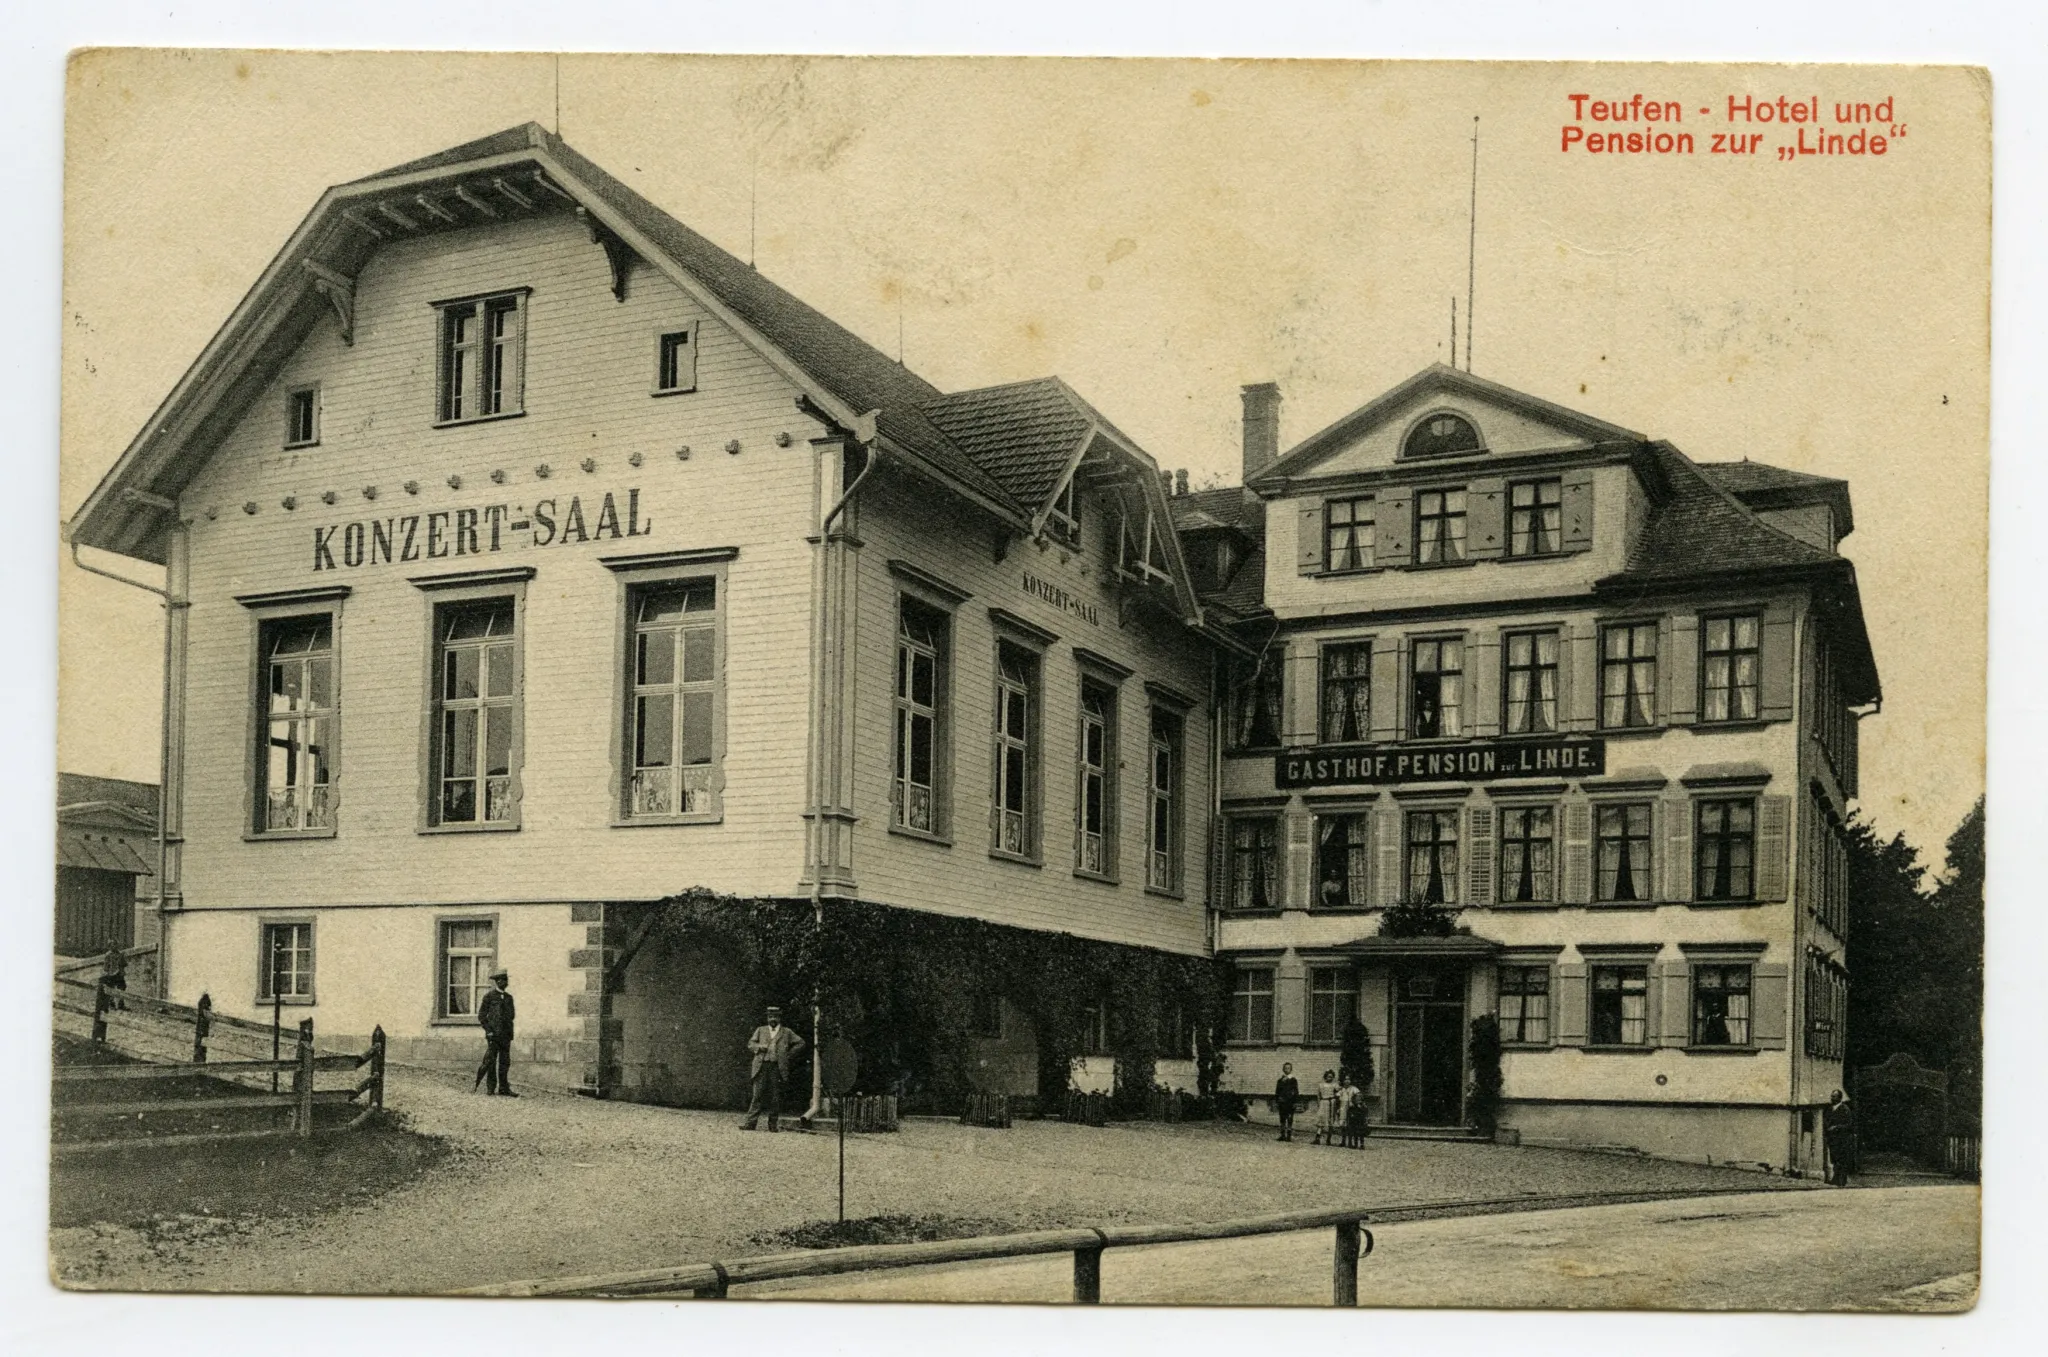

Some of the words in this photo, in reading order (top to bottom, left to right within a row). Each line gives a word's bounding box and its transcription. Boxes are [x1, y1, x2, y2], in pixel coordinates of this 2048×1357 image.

[313, 488, 652, 572] KONZERT-SAAL
[1022, 571, 1099, 627] KONZERT-SAAL
[1287, 755, 1388, 781] GASTHOF
[1398, 750, 1496, 776] PENSION
[1500, 763, 1516, 772] zur
